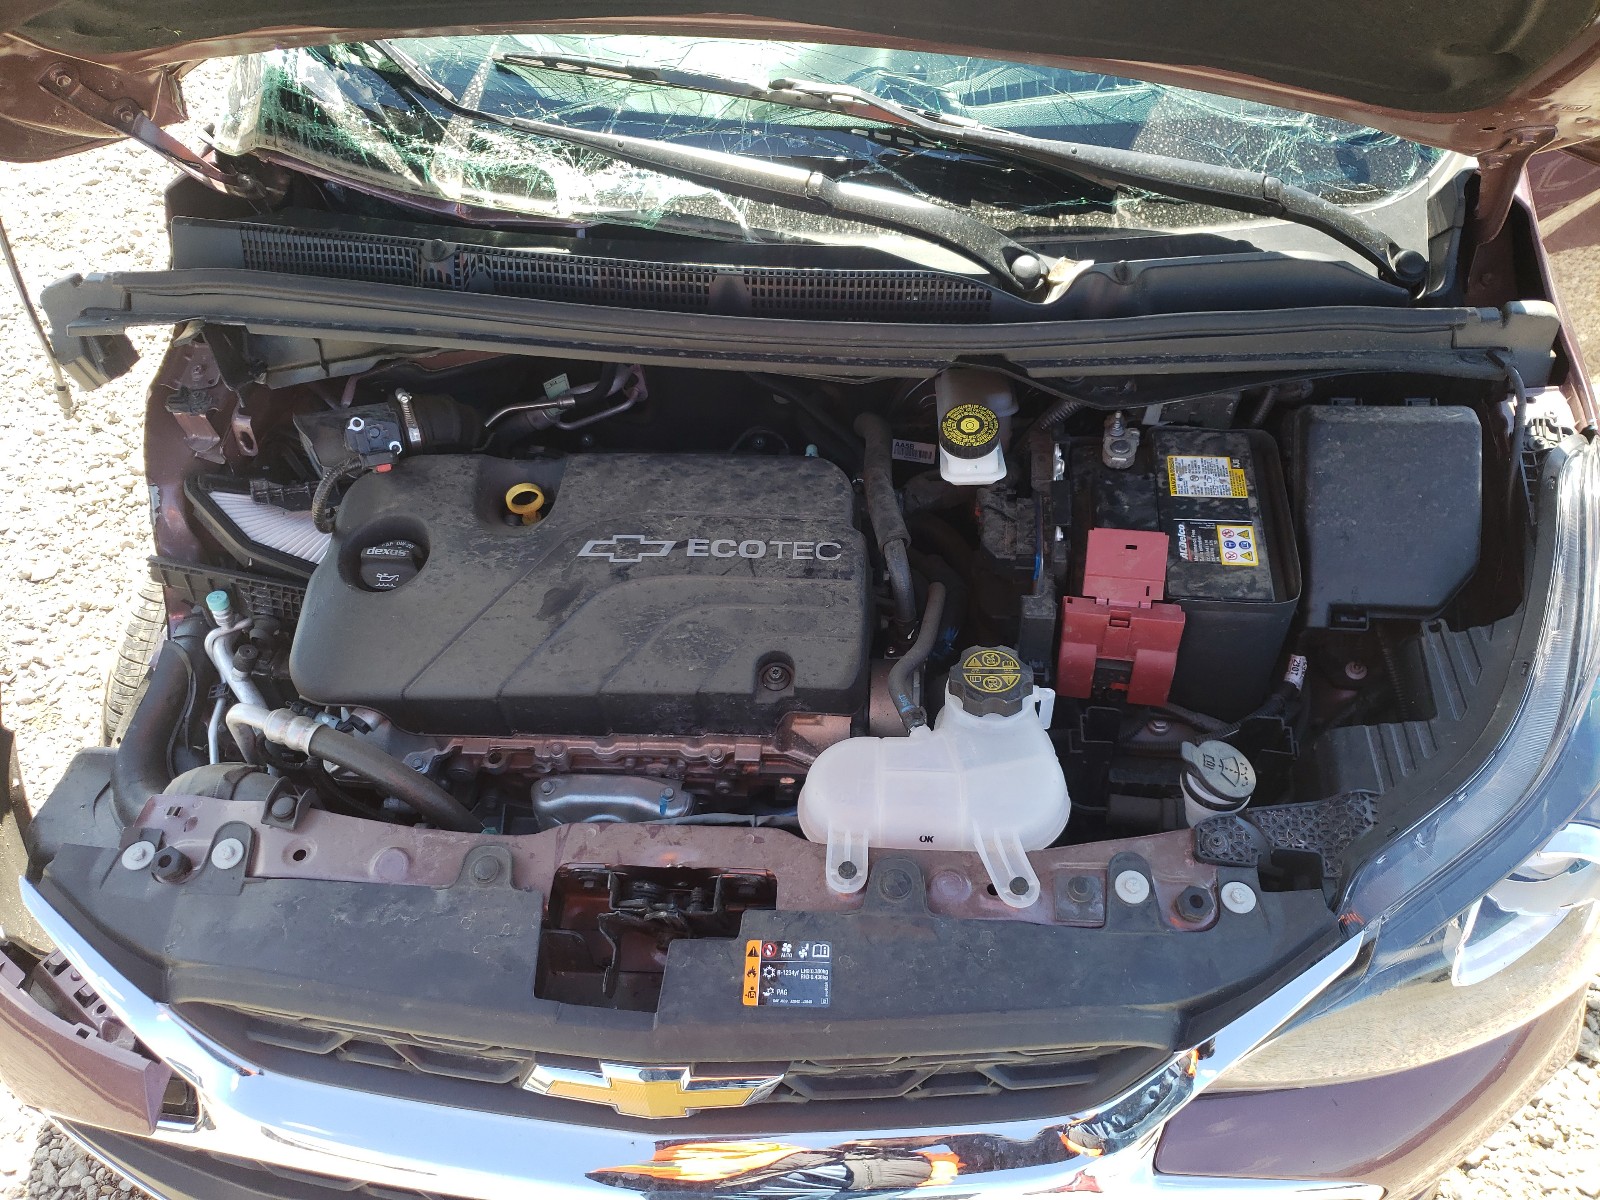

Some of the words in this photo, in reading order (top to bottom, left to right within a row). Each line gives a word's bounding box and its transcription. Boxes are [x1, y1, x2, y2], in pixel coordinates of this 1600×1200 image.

[366, 547, 407, 557] dexos
[686, 538, 842, 561] ECOTEC
[919, 835, 934, 843] OK
